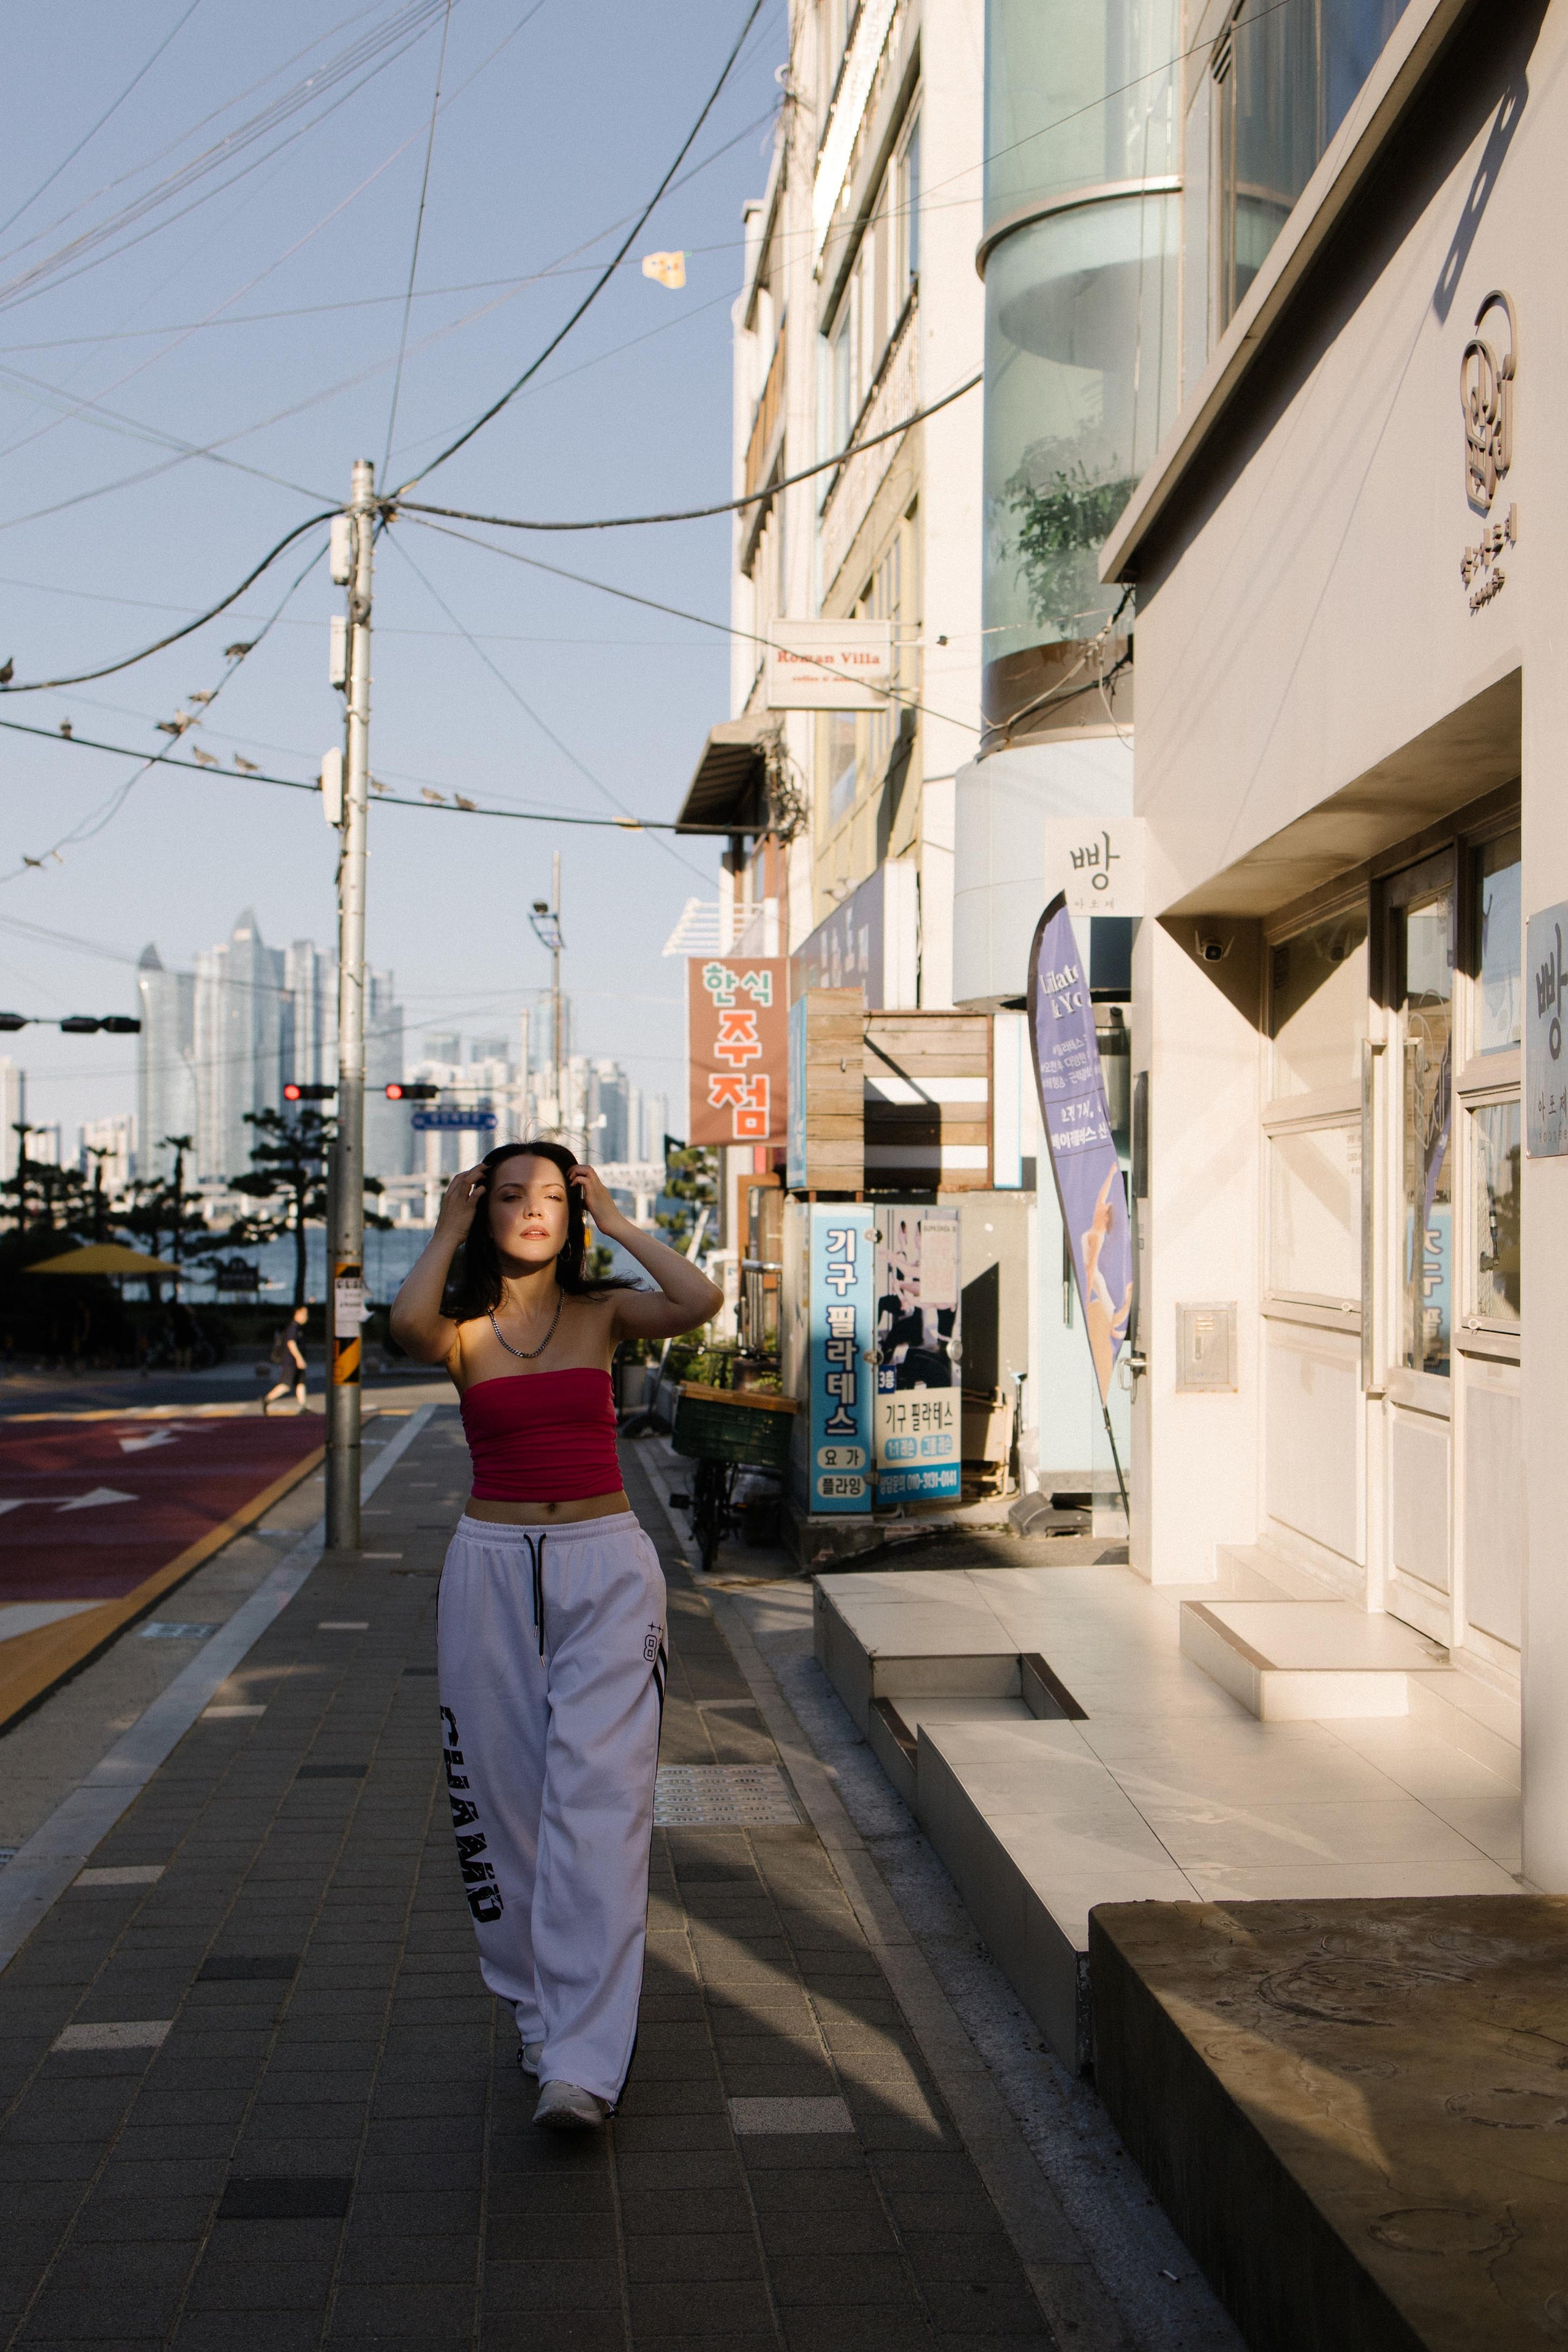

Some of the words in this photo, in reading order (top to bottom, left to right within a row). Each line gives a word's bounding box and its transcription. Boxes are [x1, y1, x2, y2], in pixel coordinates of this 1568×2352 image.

[778, 650, 834, 663] Roman
[842, 652, 881, 664] Villa
[1069, 831, 1120, 891] 빵
[703, 962, 772, 1006] 한식
[1536, 923, 1568, 1061] 빵
[707, 1010, 769, 1139] 주점
[1538, 1085, 1567, 1121] 아포제
[826, 1229, 857, 1296] 기구
[826, 1305, 859, 1435] 필라테스
[879, 1369, 895, 1389] 3층
[886, 1404, 906, 1433] 기구
[912, 1401, 953, 1432] 필라테스
[823, 1477, 861, 1495] 플라잉
